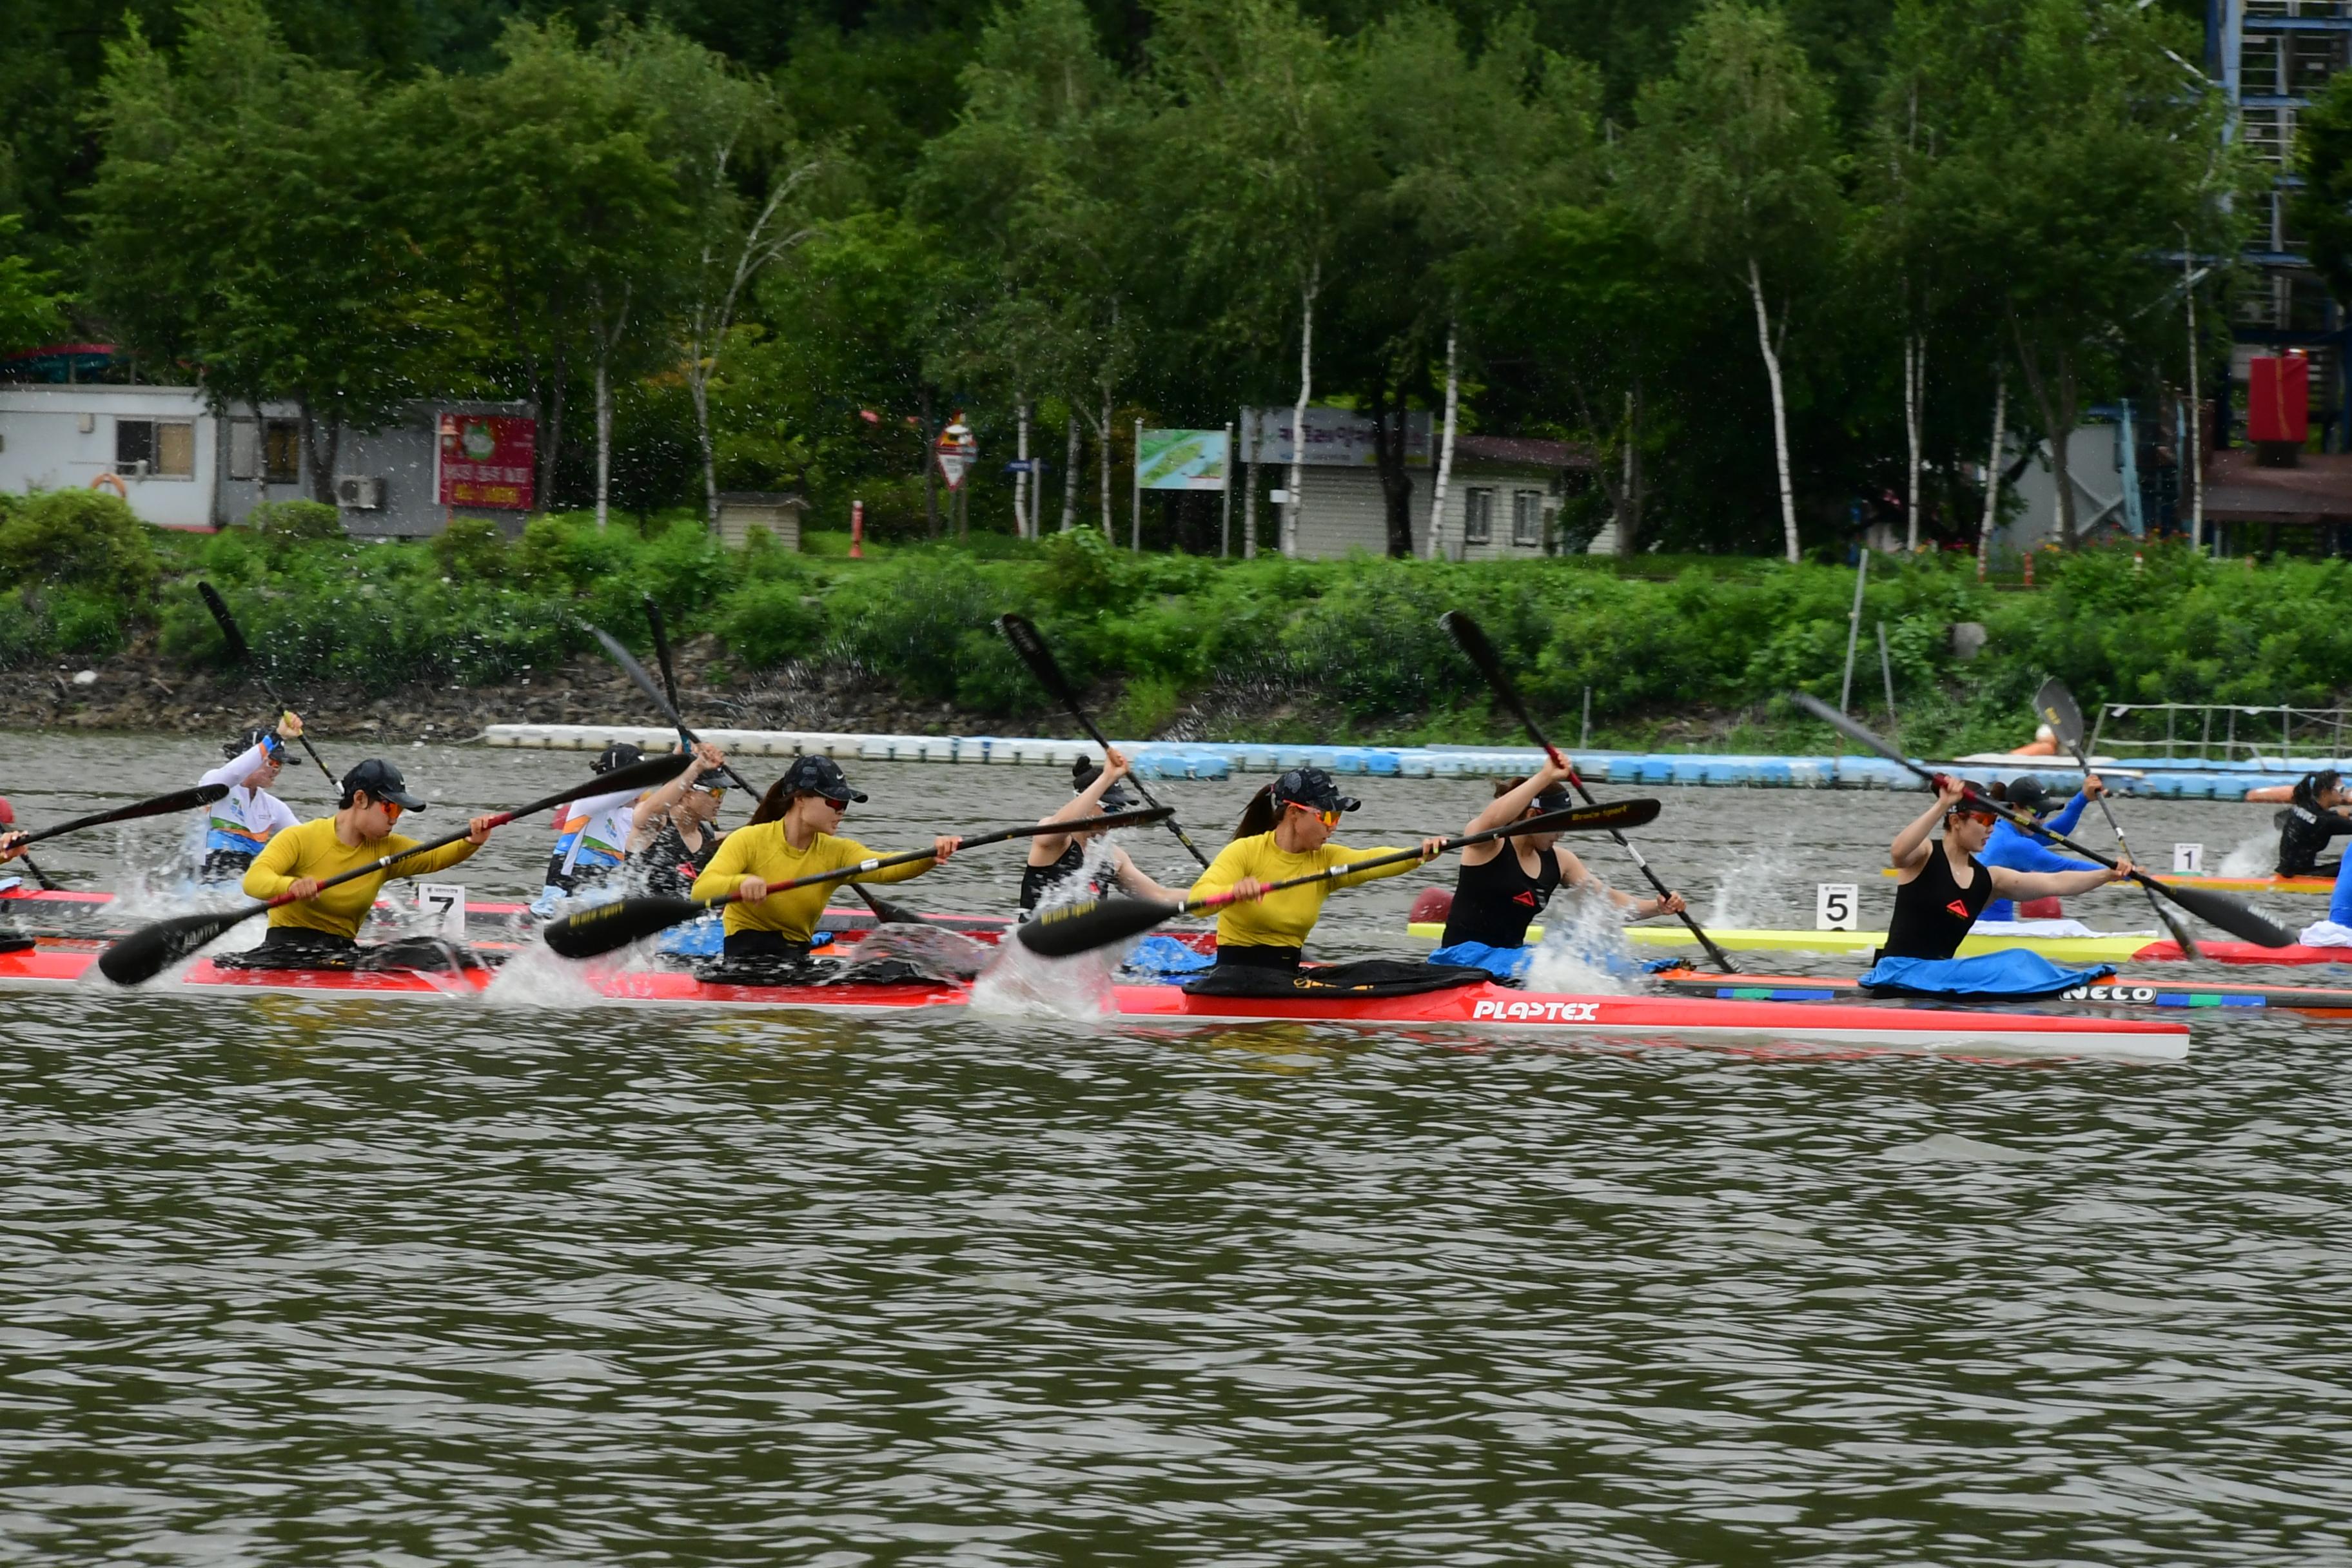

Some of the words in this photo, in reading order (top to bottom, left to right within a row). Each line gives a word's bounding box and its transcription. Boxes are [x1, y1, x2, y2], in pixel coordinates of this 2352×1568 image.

[2183, 850, 2192, 870] 1
[429, 896, 455, 926] 7
[1826, 894, 1848, 922] 5
[2063, 986, 2153, 1001] NELO
[1473, 1001, 1600, 1021] PLASTEX
